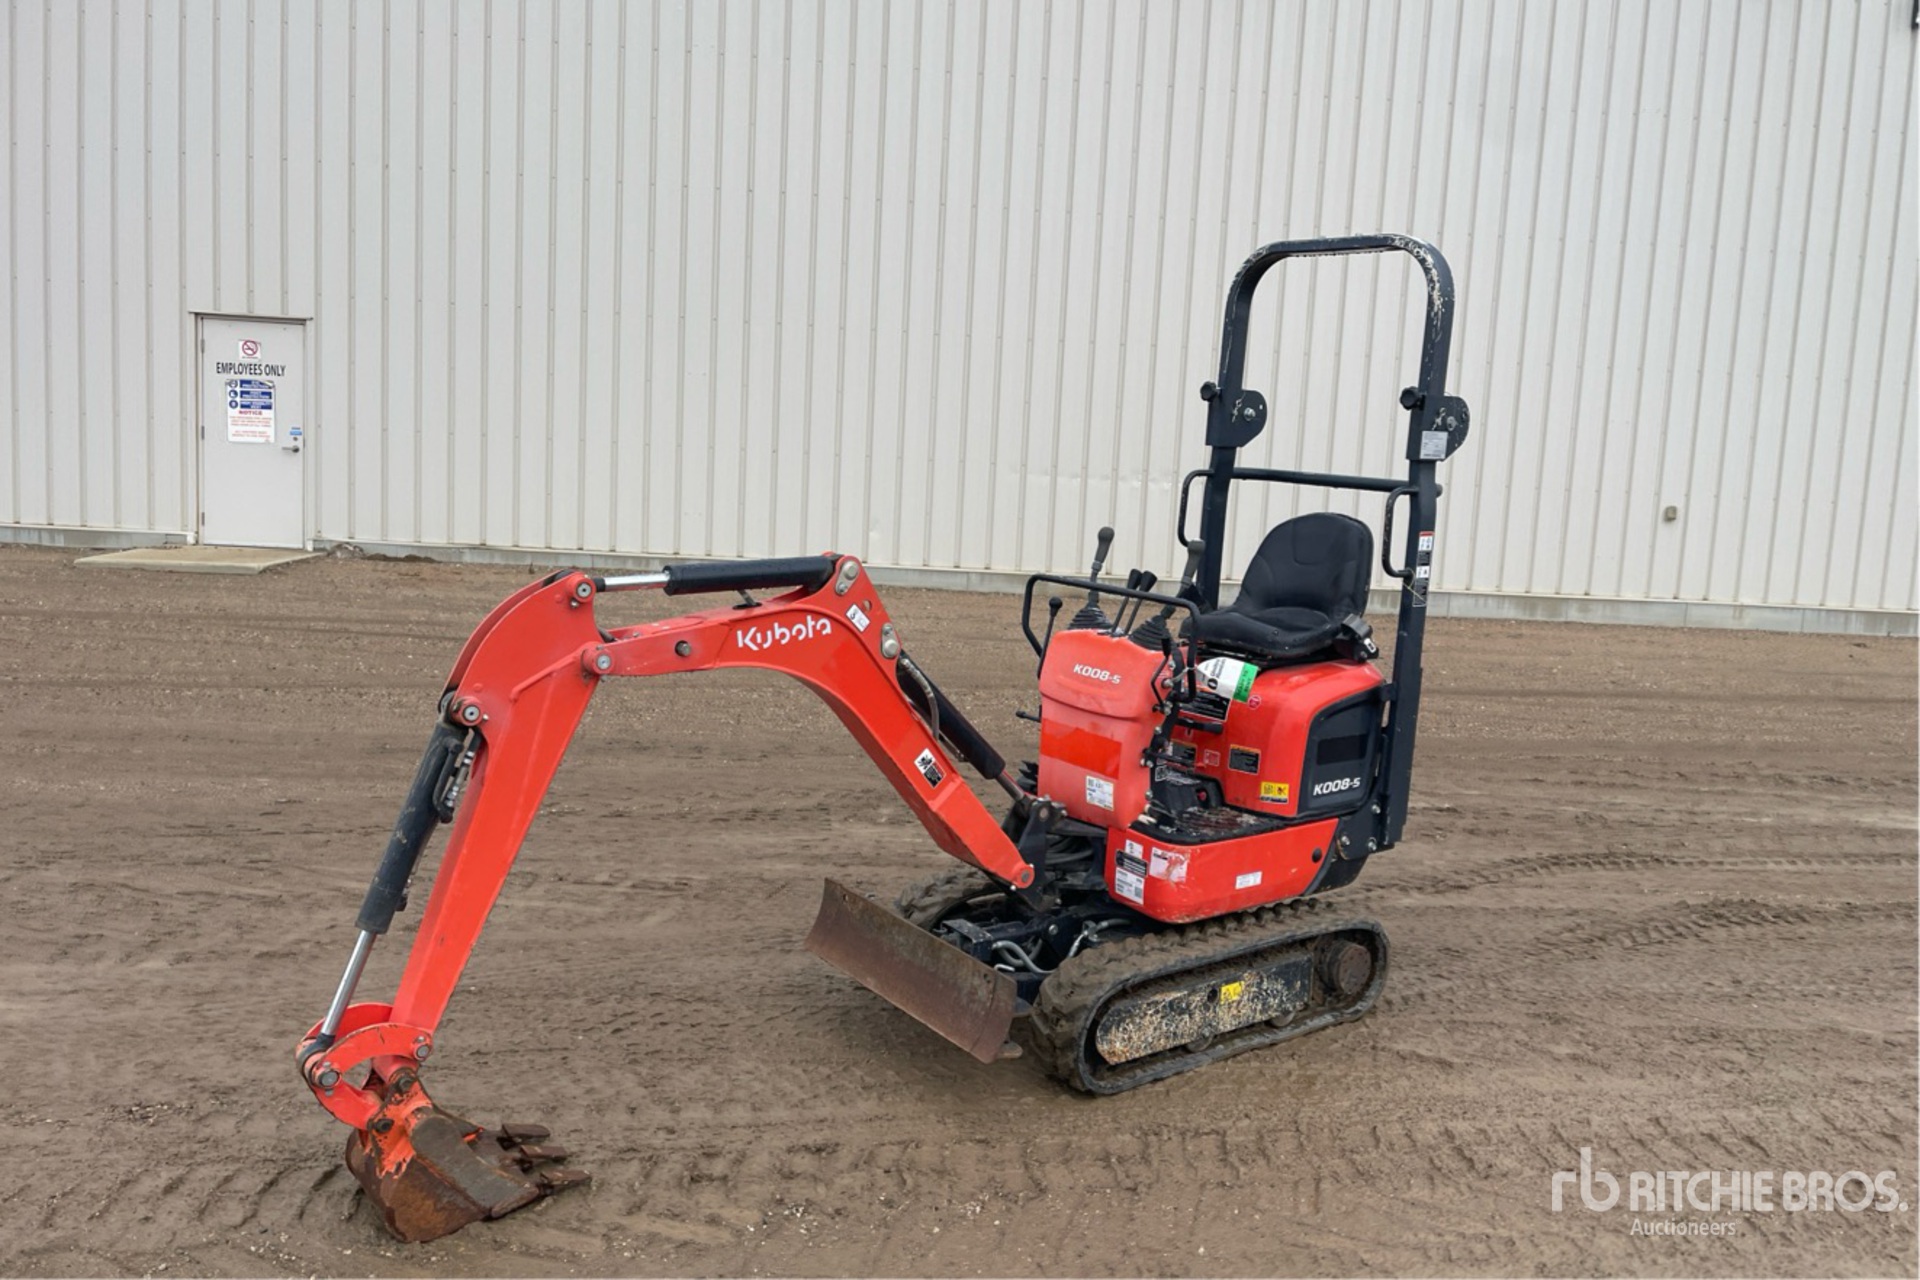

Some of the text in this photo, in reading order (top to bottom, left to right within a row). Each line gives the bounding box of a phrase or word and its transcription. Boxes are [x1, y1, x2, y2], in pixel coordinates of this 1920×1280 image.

[216, 362, 286, 377] EMPLOYEES ONLY
[736, 615, 832, 651] Kubota
[1073, 664, 1121, 684] K008-5
[1313, 777, 1361, 796] K008-5
